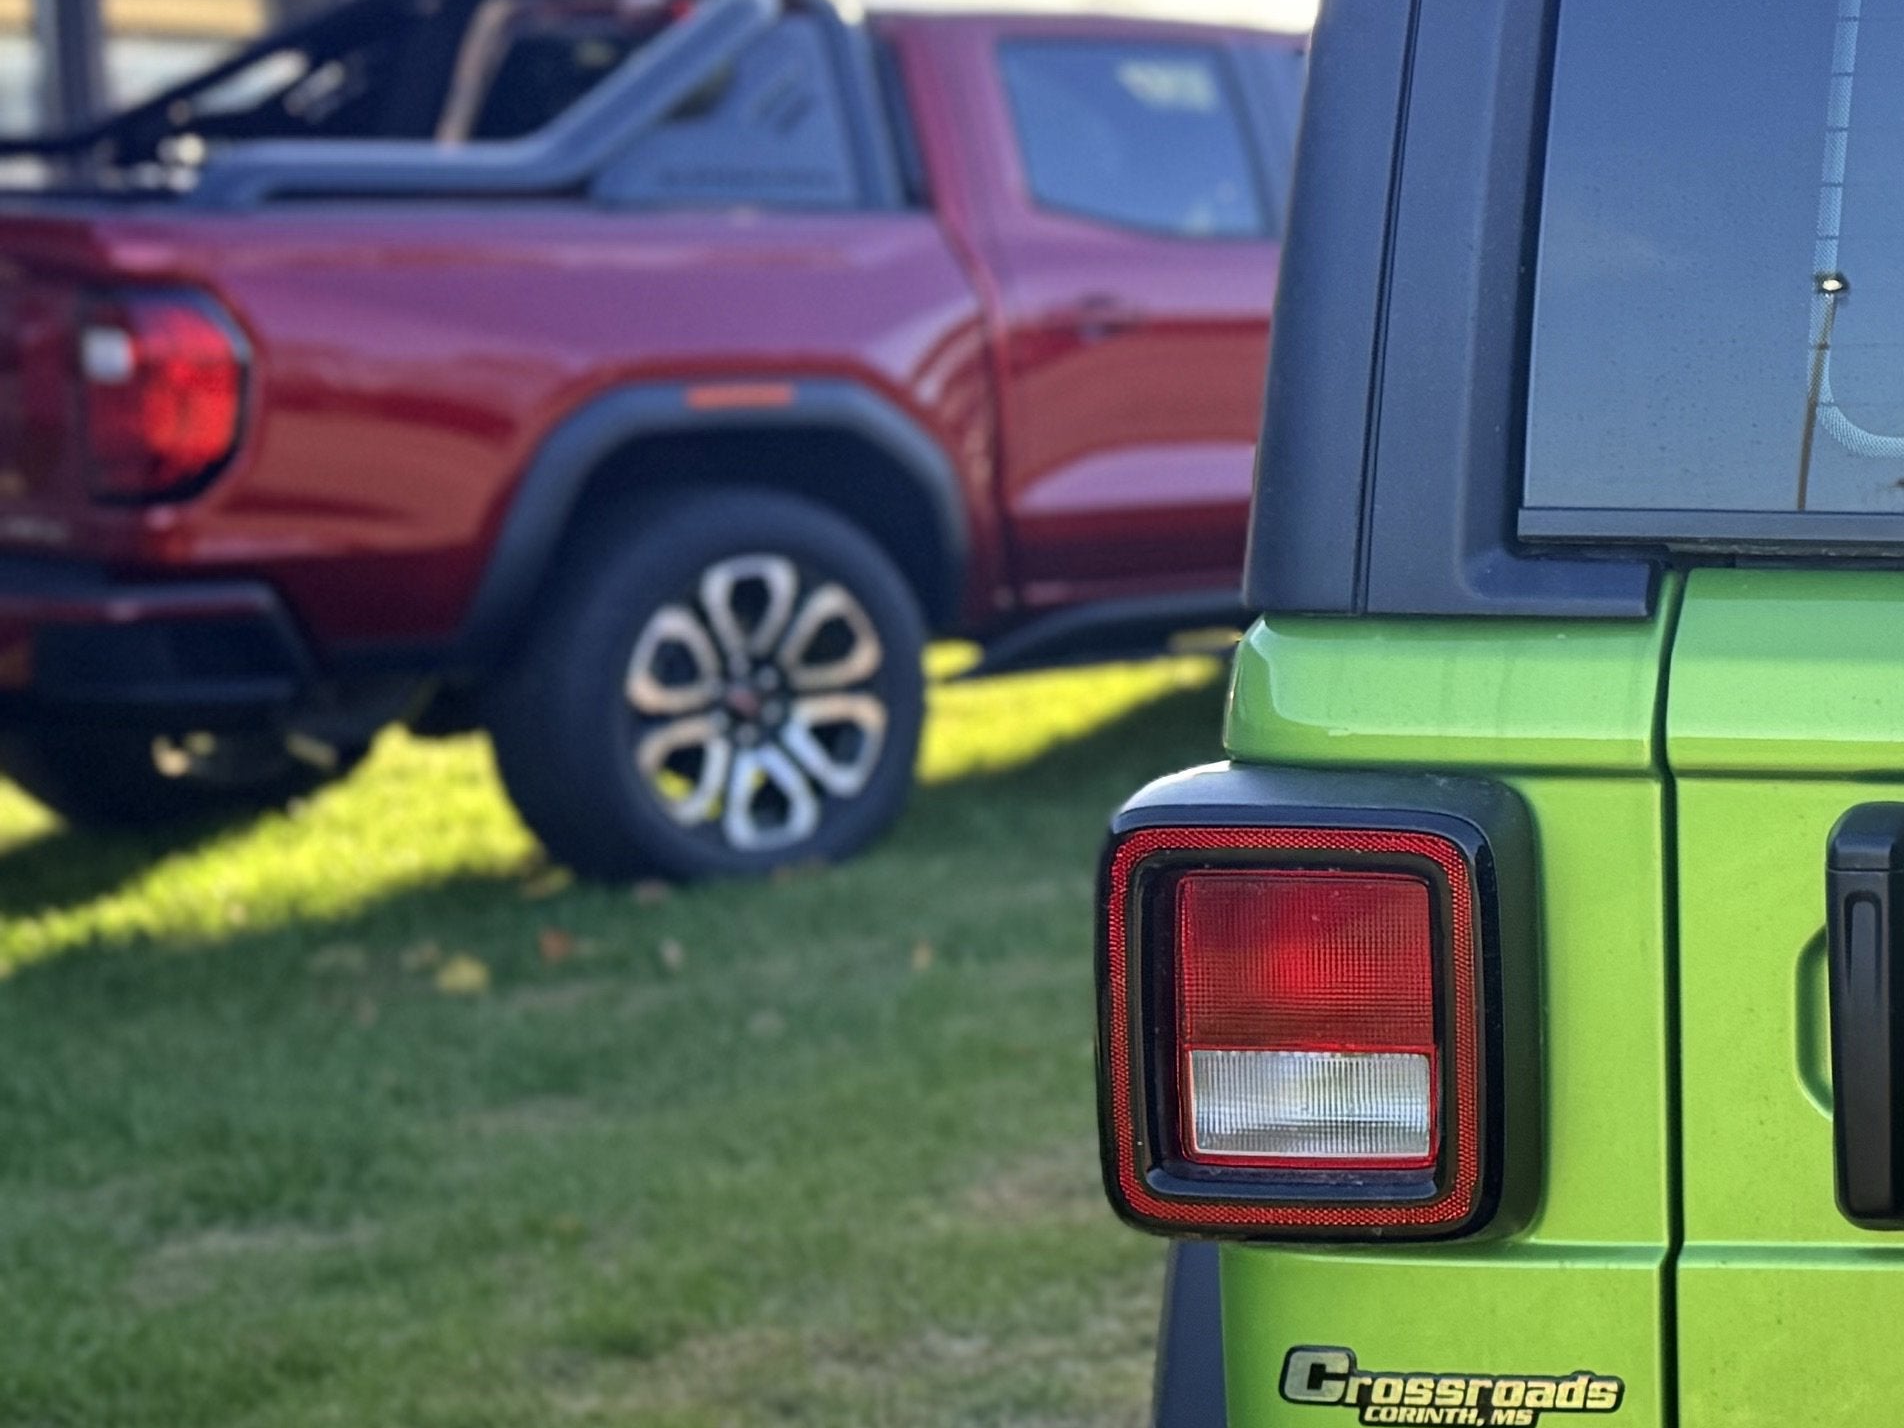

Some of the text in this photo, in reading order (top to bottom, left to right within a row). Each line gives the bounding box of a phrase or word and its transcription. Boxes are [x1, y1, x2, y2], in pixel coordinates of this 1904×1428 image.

[1284, 1349, 1619, 1410] Crossroads
[1363, 1404, 1534, 1427] CORINTH, MS
